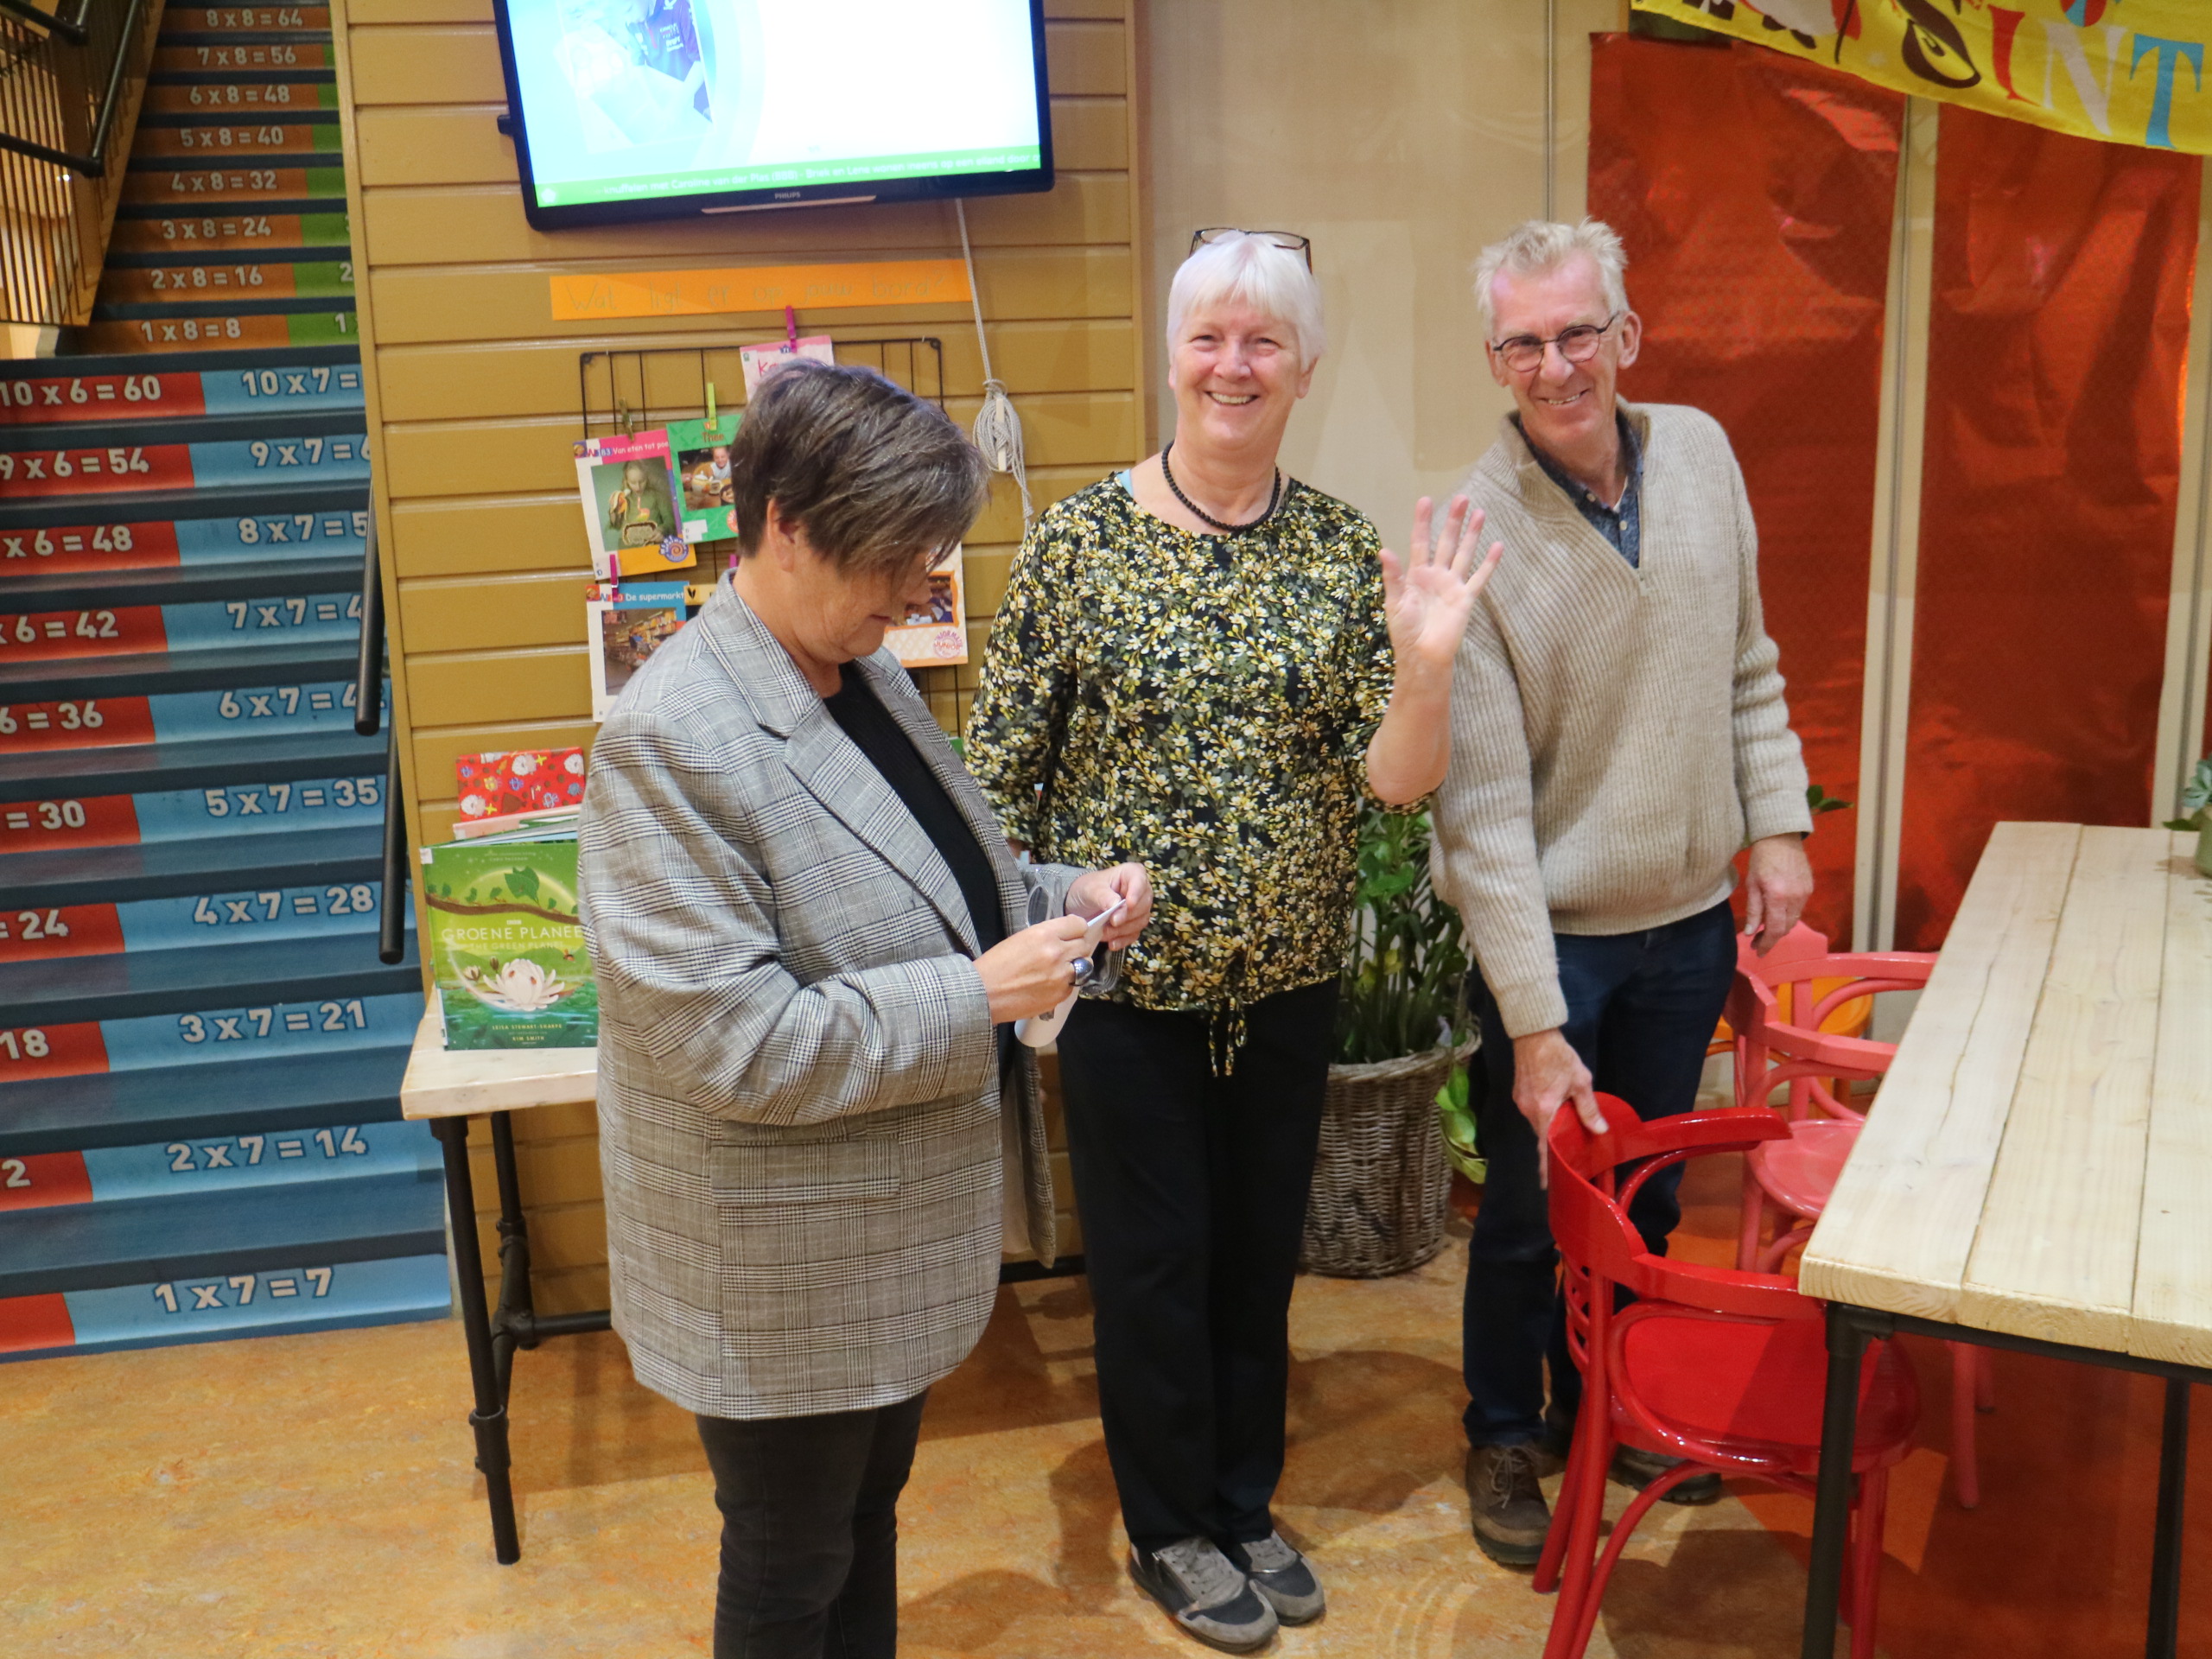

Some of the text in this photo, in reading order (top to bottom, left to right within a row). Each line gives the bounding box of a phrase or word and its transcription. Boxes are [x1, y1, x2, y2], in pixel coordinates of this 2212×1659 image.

[207, 9, 219, 27] 8
[242, 9, 254, 27] 8
[278, 9, 302, 26] 64
[197, 47, 209, 65] 7
[234, 47, 247, 65] 8
[270, 46, 296, 64] 56
[190, 86, 202, 104] 6
[226, 85, 239, 103] 8
[264, 85, 289, 103] 48
[180, 128, 194, 147] 5
[219, 127, 232, 145] 8
[257, 125, 283, 144] 40
[171, 172, 185, 192] 4
[210, 172, 224, 190] 8
[250, 170, 276, 189] 32
[162, 219, 176, 239] 3
[202, 219, 216, 238] 8
[242, 217, 271, 237] 24
[150, 268, 166, 289] 2
[192, 267, 207, 288] 8
[235, 265, 264, 286] 16
[142, 321, 154, 342] 1
[183, 319, 198, 340] 8
[226, 317, 241, 339] 8
[0, 381, 34, 406] 10
[70, 378, 88, 404] 6
[124, 375, 162, 401] 60
[242, 370, 279, 396] 10
[311, 367, 330, 392] 7
[0, 454, 15, 480] 9
[54, 450, 73, 477] 6
[108, 447, 149, 474] 54
[251, 441, 269, 467] 9
[303, 437, 323, 464] 7
[35, 529, 54, 556] 6
[92, 525, 133, 552] 48
[238, 518, 259, 543] 8
[294, 514, 314, 540] 7
[352, 511, 368, 537] 5
[16, 615, 36, 643] 6
[75, 610, 119, 639] 42
[226, 601, 247, 628] 7
[286, 598, 307, 624] 7
[346, 594, 362, 620] 4
[0, 707, 17, 734] 6
[58, 701, 104, 729] 36
[219, 691, 240, 718] 6
[278, 687, 300, 715] 7
[205, 789, 229, 817] 5
[268, 784, 291, 811] 7
[334, 778, 378, 807] 35
[38, 799, 86, 830] 30
[194, 897, 219, 925] 4
[257, 891, 282, 919] 7
[327, 884, 374, 914] 28
[18, 909, 69, 940] 24
[442, 927, 513, 940] GROENE
[180, 1014, 206, 1043] 3
[248, 1007, 272, 1036] 7
[320, 1000, 365, 1031] 21
[0, 1028, 49, 1059] 18
[167, 1143, 195, 1171] 2
[238, 1135, 264, 1164] 7
[315, 1127, 366, 1157] 14
[155, 1283, 177, 1312] 1
[228, 1274, 256, 1304] 7
[305, 1267, 332, 1296] 7
